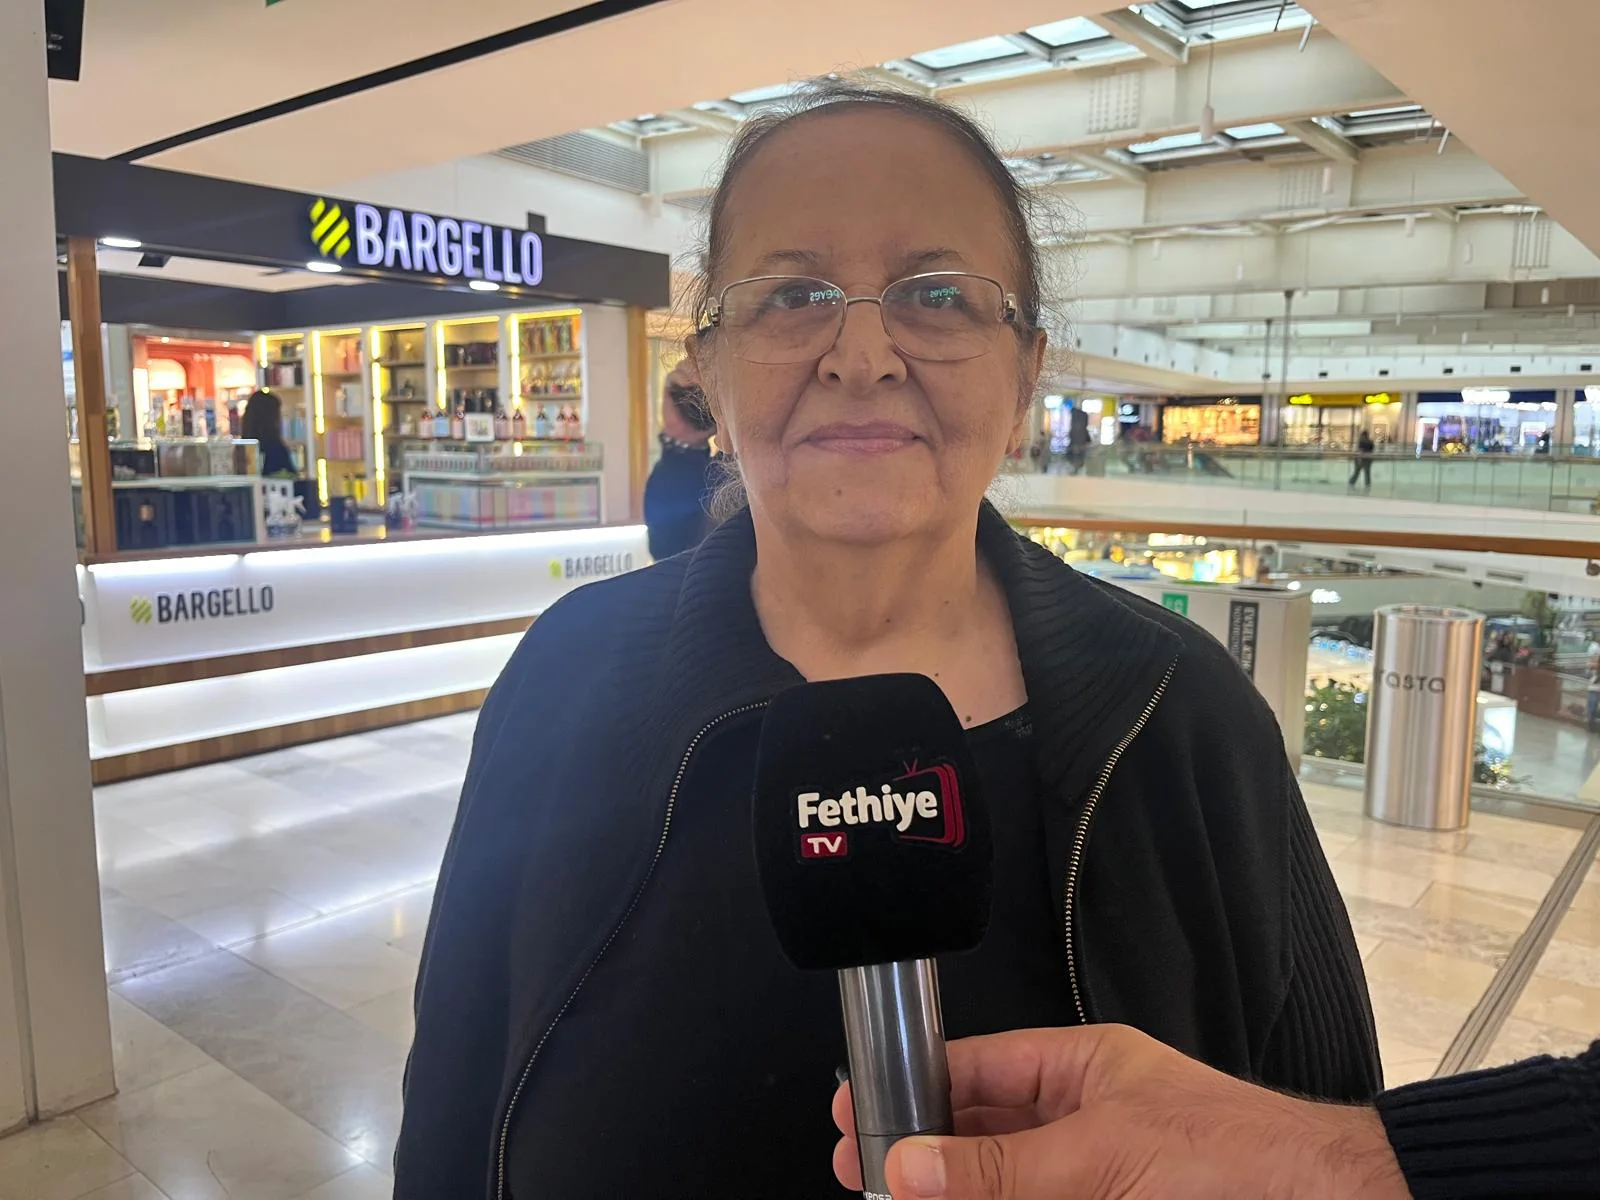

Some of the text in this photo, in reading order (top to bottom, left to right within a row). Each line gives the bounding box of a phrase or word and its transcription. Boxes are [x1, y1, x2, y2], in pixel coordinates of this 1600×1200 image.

[355, 203, 543, 286] BARGELLO
[565, 552, 633, 578] BARGELLO
[157, 585, 274, 624] BARGELLO
[798, 783, 938, 832] Fethiye
[807, 836, 842, 854] TV
